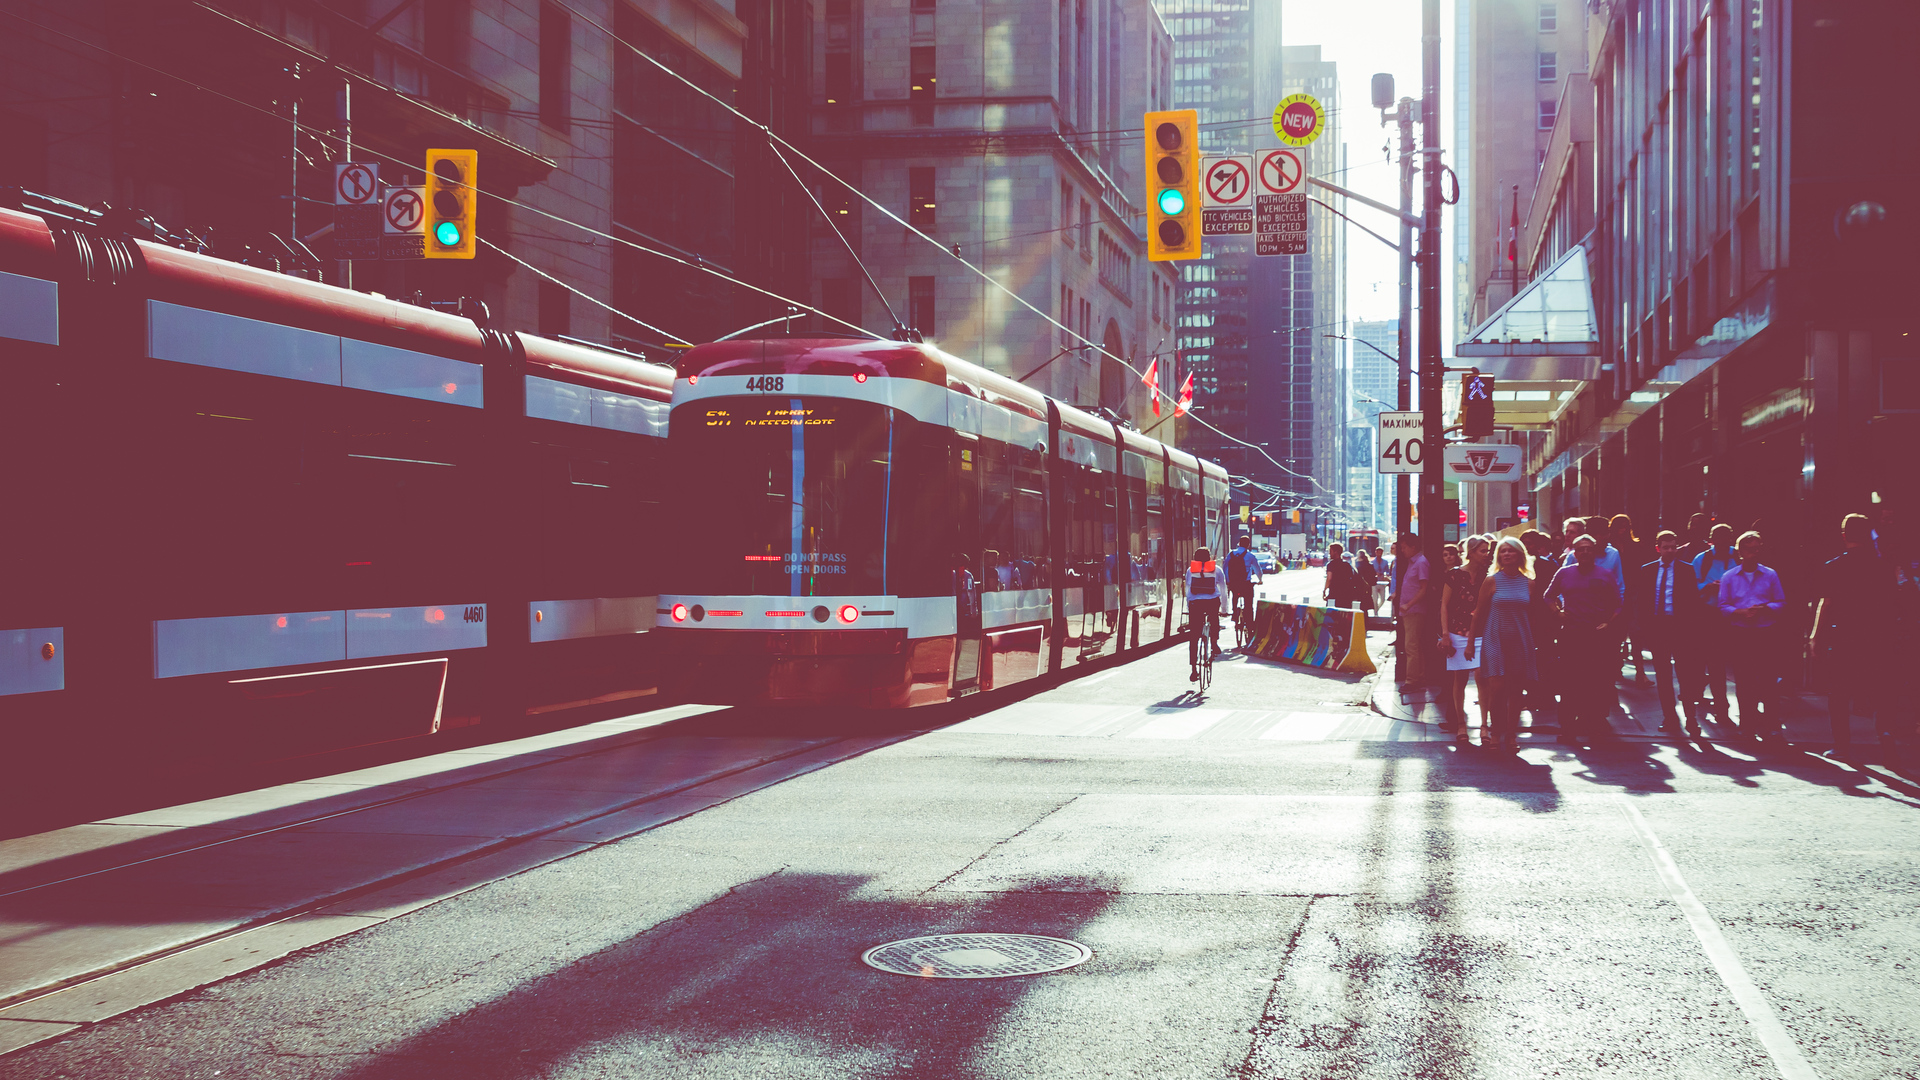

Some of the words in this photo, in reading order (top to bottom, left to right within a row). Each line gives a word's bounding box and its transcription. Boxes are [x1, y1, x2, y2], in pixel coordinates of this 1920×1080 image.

[1283, 112, 1313, 129] NEW
[1258, 194, 1305, 204] AUTHORIZED
[1263, 204, 1299, 212] VEHICLES
[1204, 213, 1217, 221] TTC
[1220, 212, 1251, 221] VEHICLES
[1258, 213, 1272, 222] AND
[1275, 213, 1305, 222] BICYCLES
[1205, 222, 1250, 232] EXCEPTED
[1263, 222, 1301, 232] EXCEPTED
[1257, 233, 1274, 243] TAXIS
[1277, 232, 1307, 242] EXCEPTED
[746, 376, 784, 391] 4488
[1382, 419, 1424, 429] MAXIMUM
[1382, 438, 1424, 465] 40
[784, 553, 798, 562] DO
[800, 553, 819, 562] NOT
[822, 553, 847, 562] PASS
[784, 565, 810, 574] OPEN
[813, 565, 847, 574] DOORS
[464, 606, 484, 623] 4460
